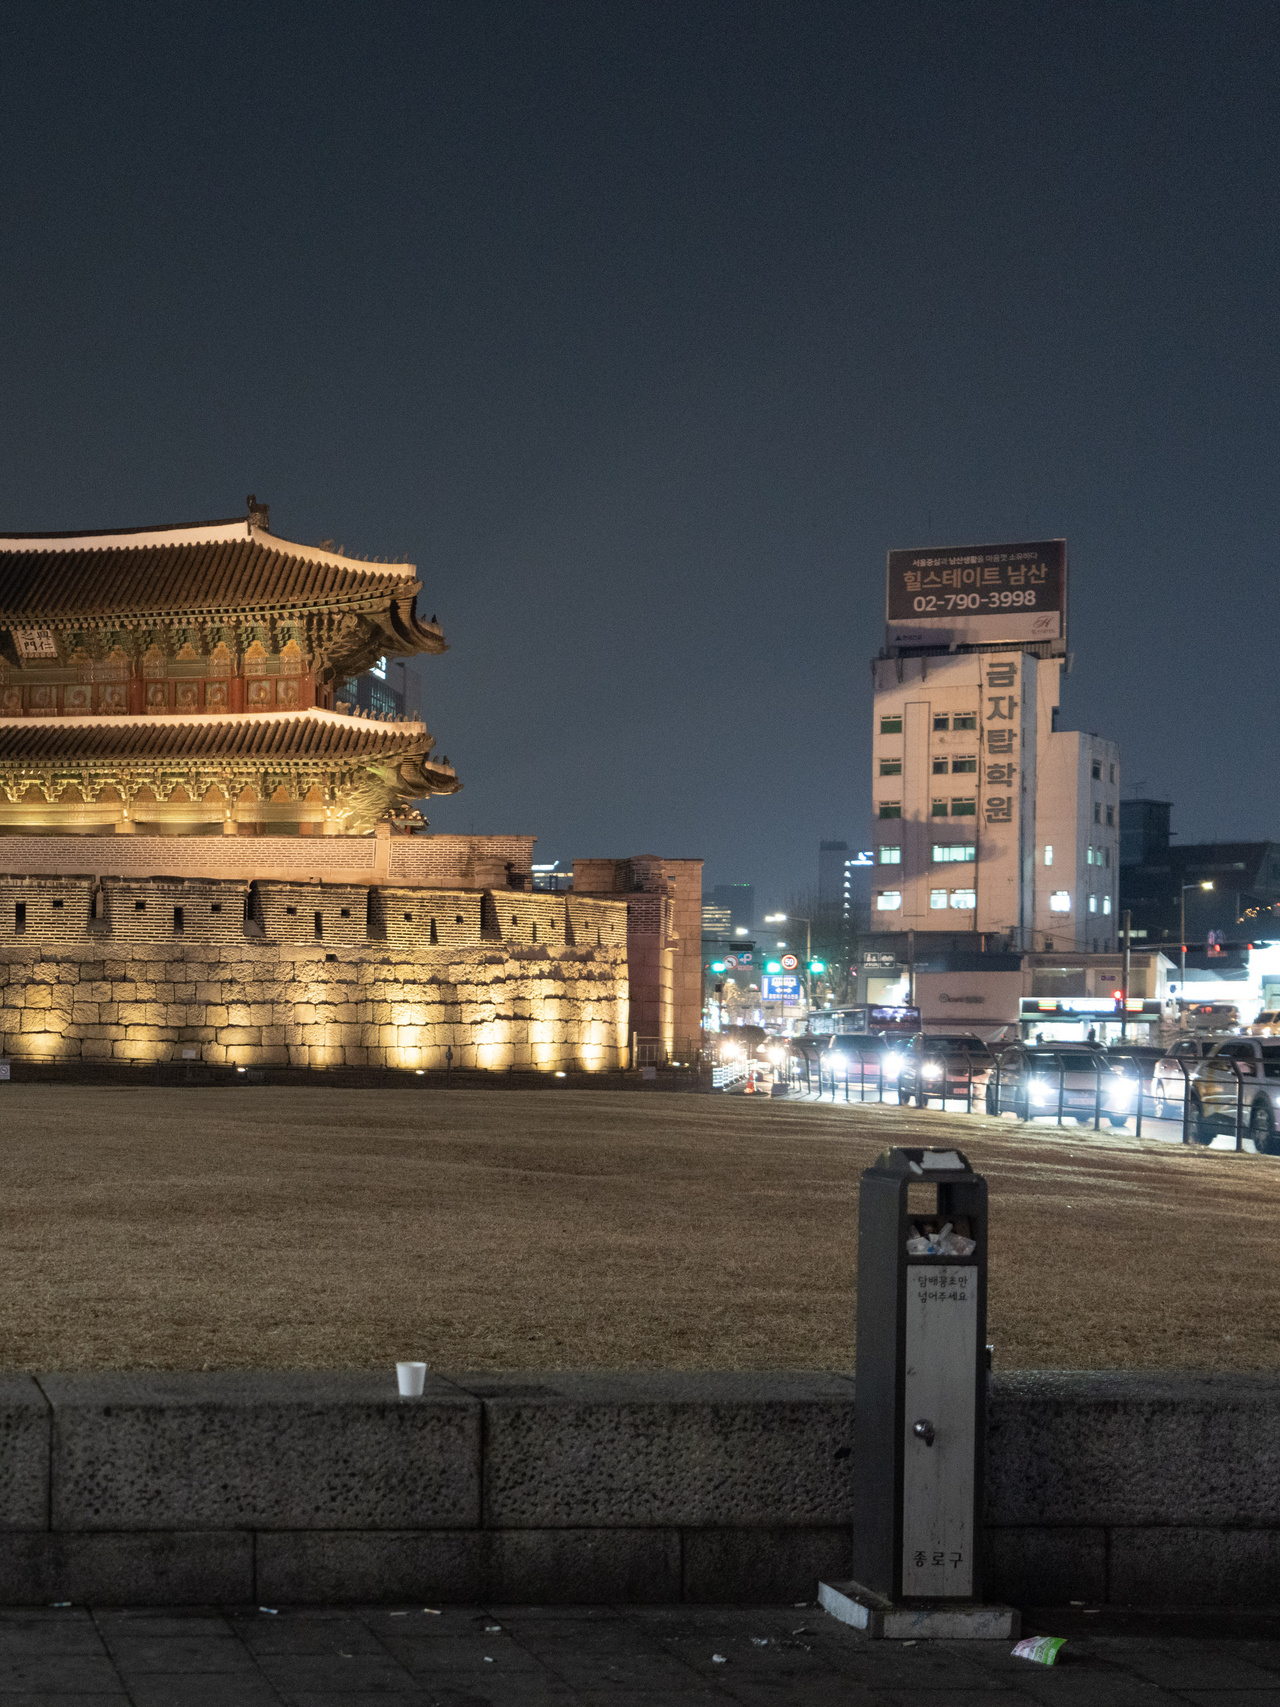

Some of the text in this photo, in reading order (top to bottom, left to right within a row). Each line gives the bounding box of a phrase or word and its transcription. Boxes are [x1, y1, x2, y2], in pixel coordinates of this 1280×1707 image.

[903, 563, 1048, 592] 힐스테이트 남산
[913, 590, 1037, 612] 02-790-3998
[986, 662, 1018, 824] 금자탑학원
[784, 958, 794, 966] 50
[918, 1292, 967, 1303] 넣어주세요
[913, 1550, 964, 1569] 종로구
